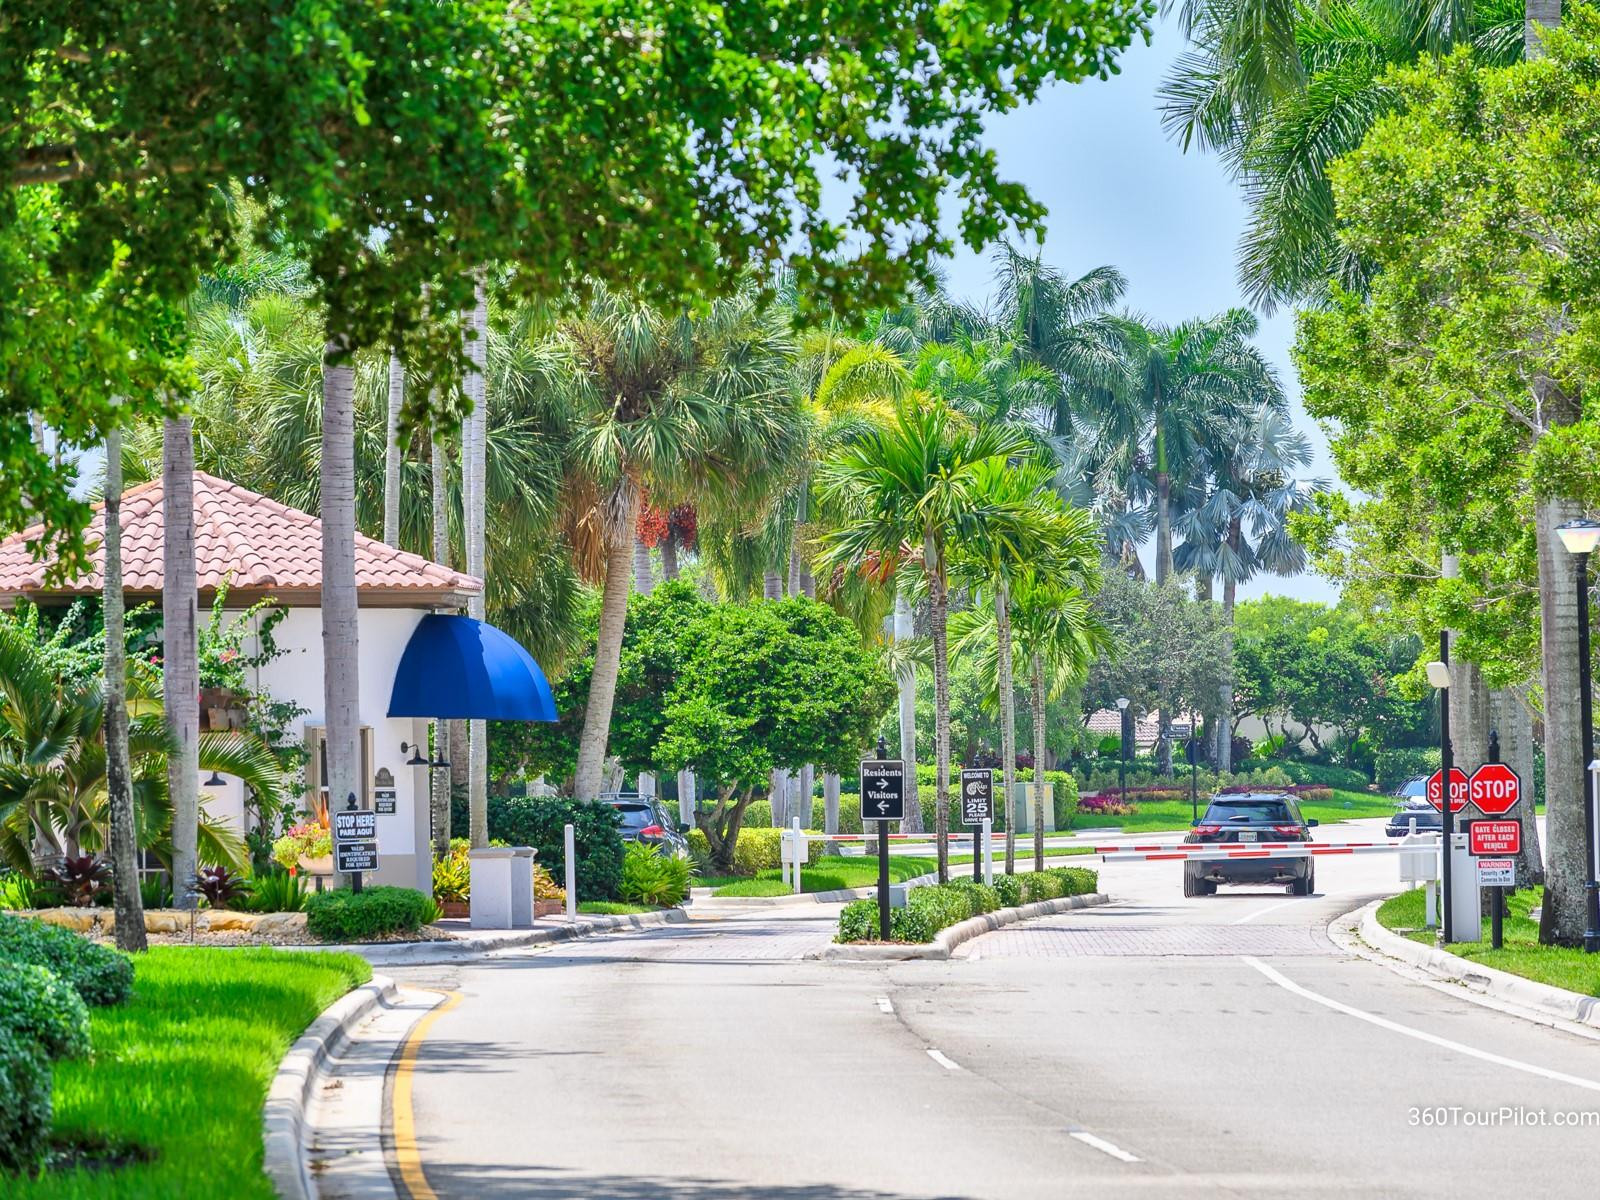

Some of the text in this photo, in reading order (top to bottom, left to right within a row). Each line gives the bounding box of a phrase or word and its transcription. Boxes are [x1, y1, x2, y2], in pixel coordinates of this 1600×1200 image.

[863, 768, 902, 777] Residents
[867, 790, 899, 799] Visitors
[1430, 782, 1468, 798] SOP
[1472, 780, 1516, 799] STOP
[966, 803, 989, 813] 25
[337, 815, 374, 829] STOP HERE
[1492, 825, 1516, 833] CLOSES
